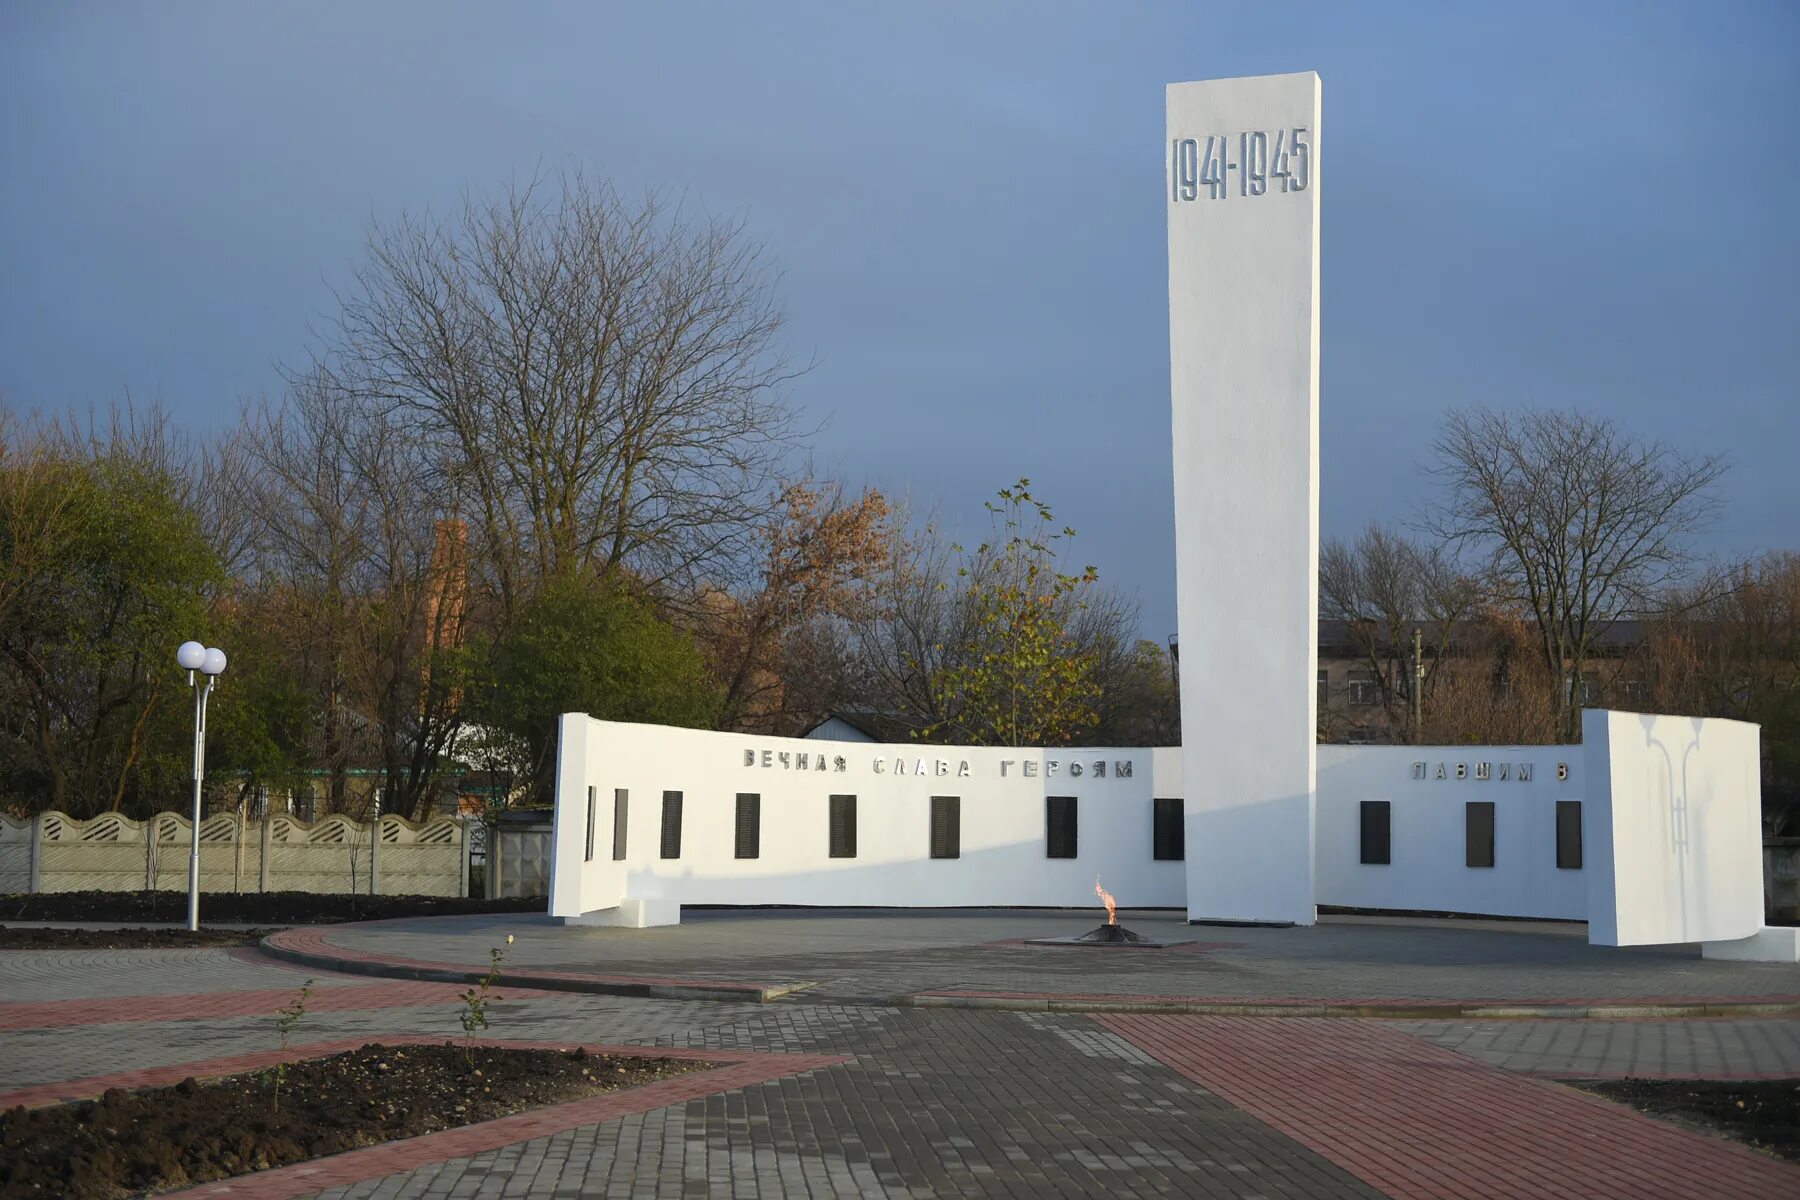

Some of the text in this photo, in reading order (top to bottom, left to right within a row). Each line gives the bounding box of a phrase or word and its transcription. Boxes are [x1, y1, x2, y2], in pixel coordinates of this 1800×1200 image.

[1172, 125, 1310, 202] 1941-1945
[743, 749, 1570, 782] ВЕЧНАЯ СЛАВА ГЕРОЯМ ПАВШИМ В
